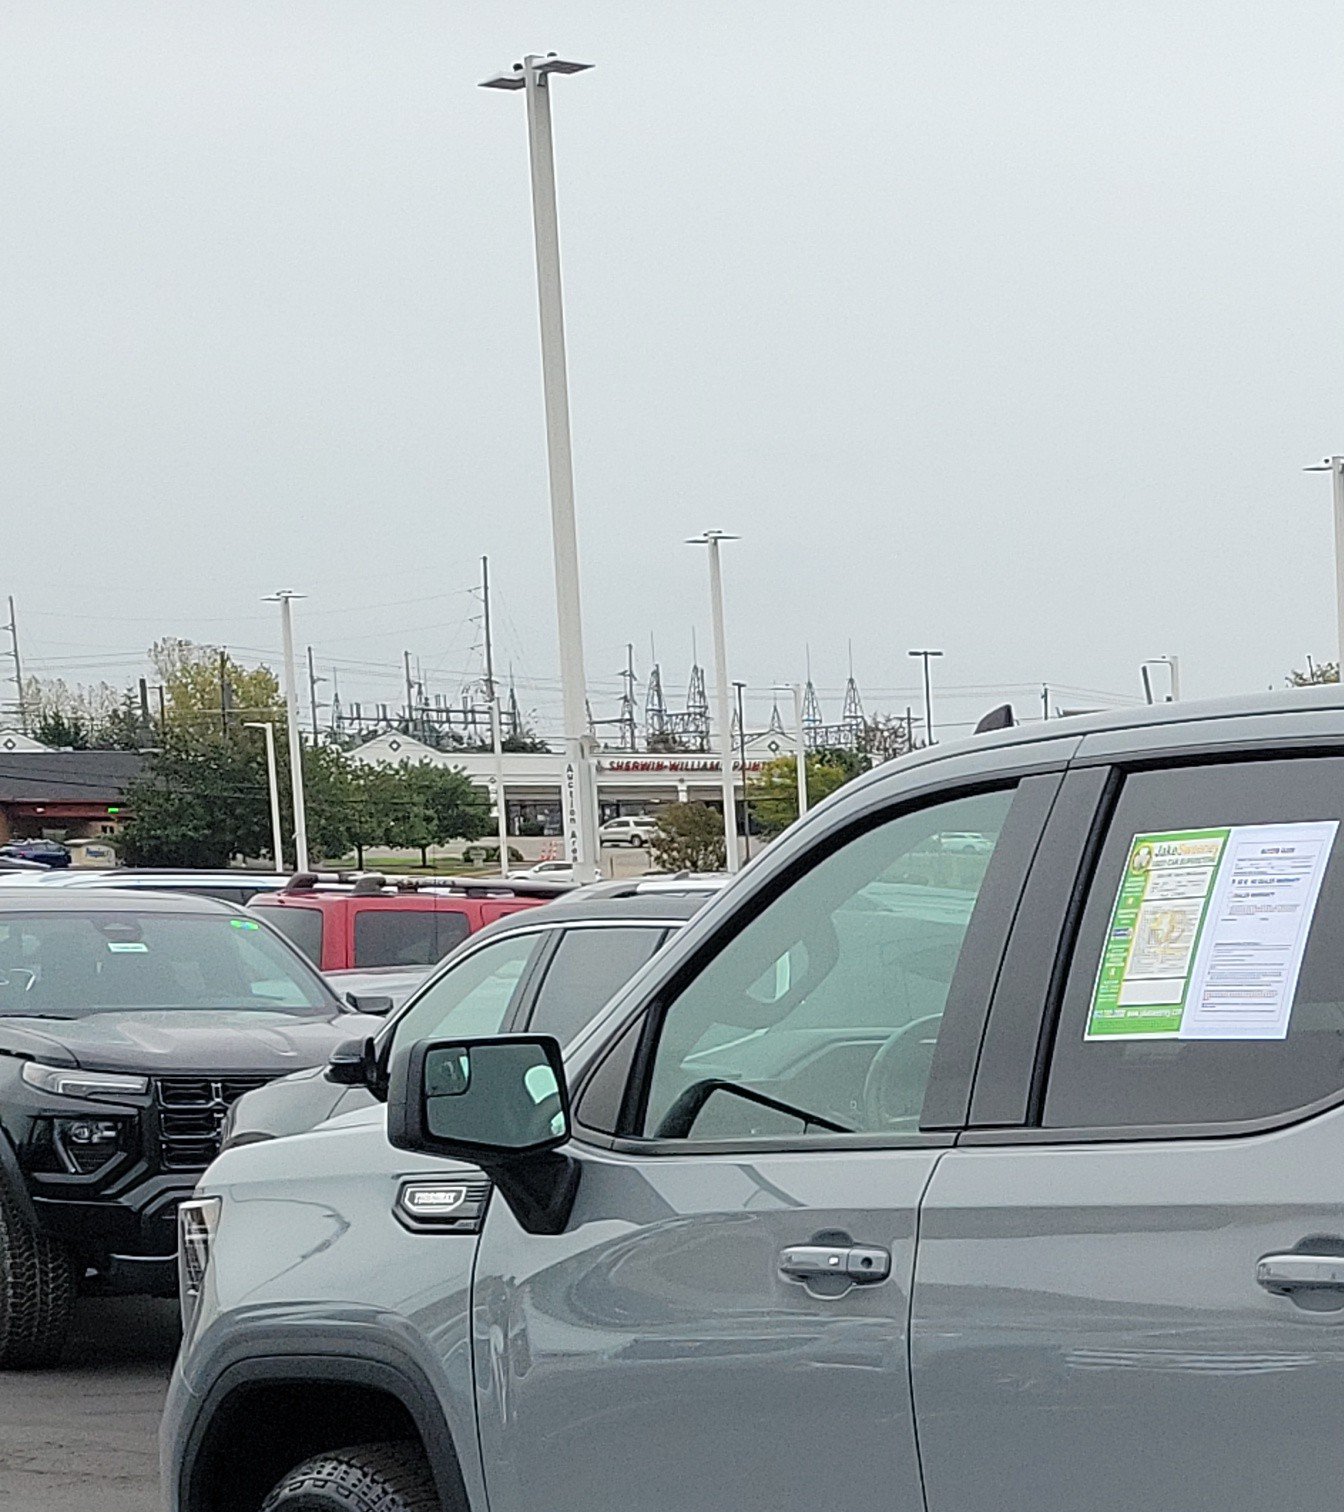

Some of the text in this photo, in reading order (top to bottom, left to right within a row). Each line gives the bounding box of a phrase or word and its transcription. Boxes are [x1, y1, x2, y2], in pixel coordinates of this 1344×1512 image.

[609, 761, 723, 772] SHERWIN-WILLIAM
[566, 764, 578, 862] Auction Area
